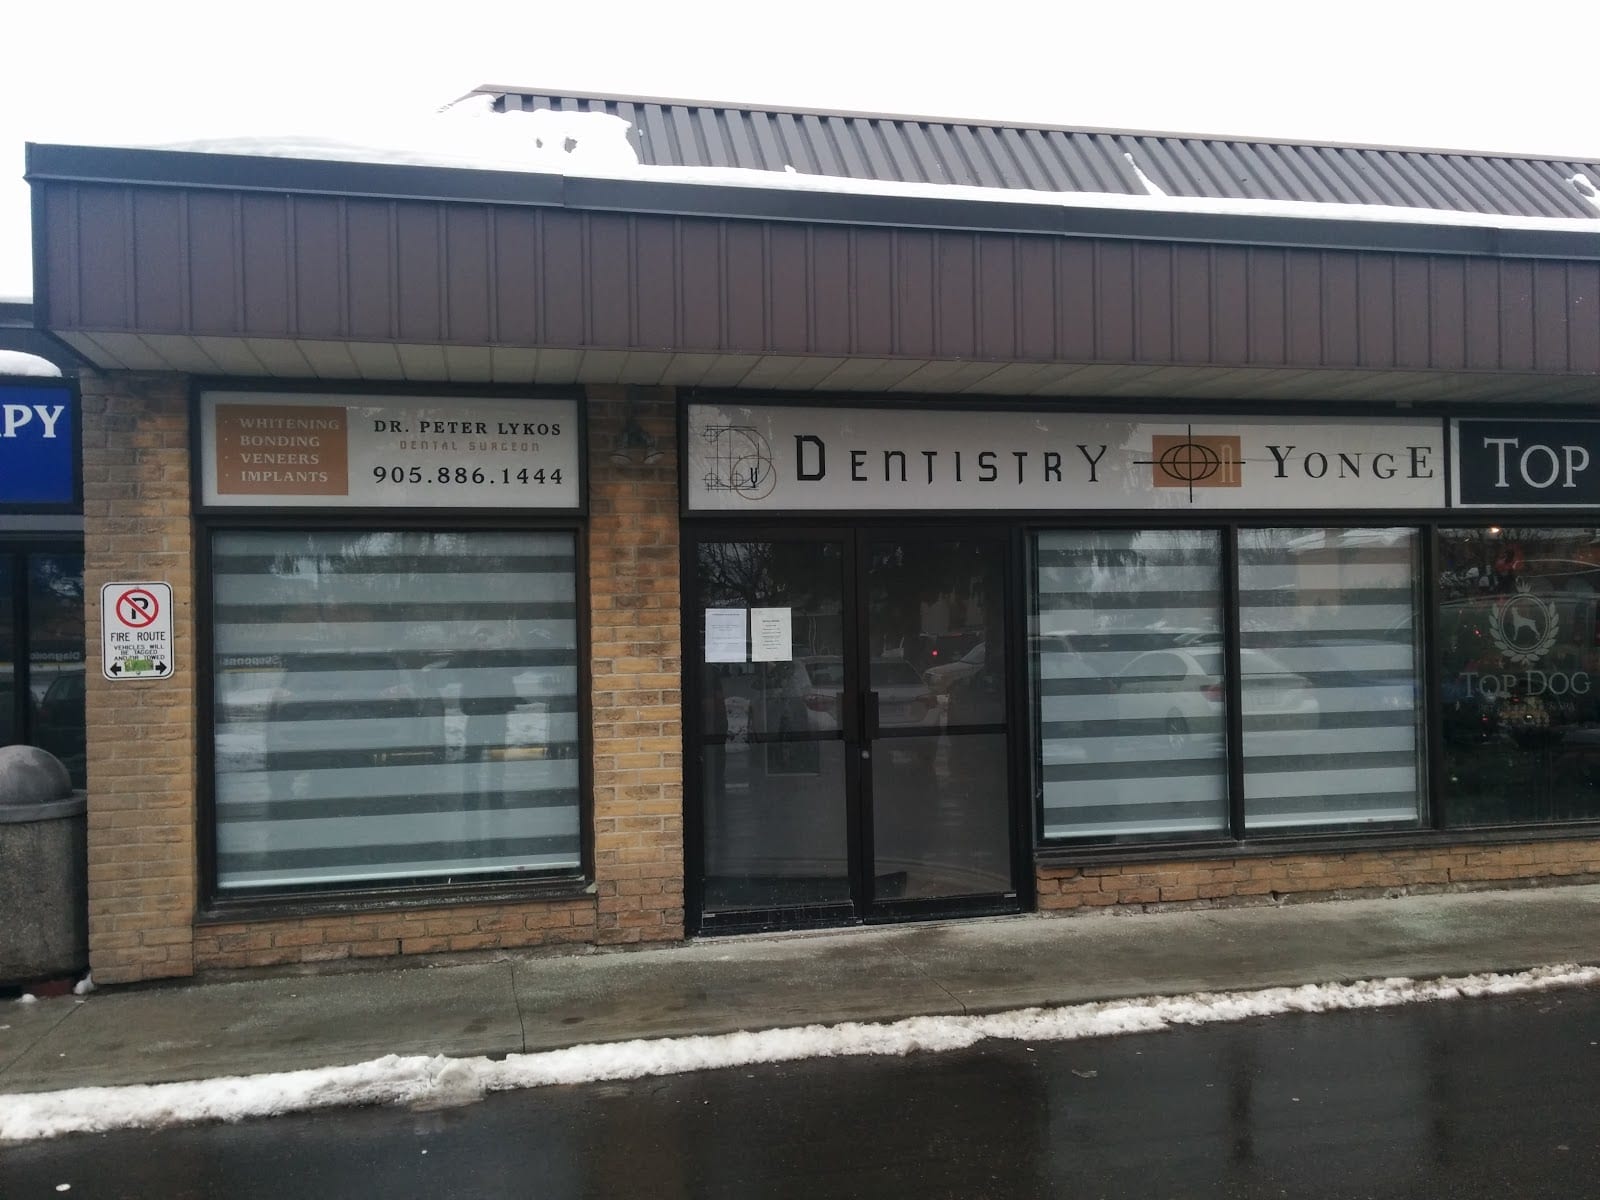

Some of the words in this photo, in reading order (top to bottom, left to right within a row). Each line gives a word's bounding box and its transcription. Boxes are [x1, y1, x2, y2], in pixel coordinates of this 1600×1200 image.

[0, 404, 65, 438] PY
[240, 417, 340, 430] WHITENING
[374, 420, 409, 433] DR.
[420, 421, 488, 434] PETER
[498, 422, 561, 436] LYKOS
[240, 435, 320, 447] BONDING
[400, 440, 458, 451] DENTAL
[469, 441, 540, 452] SURGEON
[240, 453, 320, 465] VENEERS
[793, 434, 1107, 485] DENTISTRY
[1265, 445, 1434, 479] YONGE
[1483, 437, 1590, 490] TOP
[241, 471, 328, 482] IMPLANTS
[373, 466, 562, 484] 905.886.1444
[110, 632, 130, 642] FIRE
[137, 631, 166, 641] ROUTE
[1459, 671, 1517, 698] TOP
[1525, 670, 1592, 695] DOG
